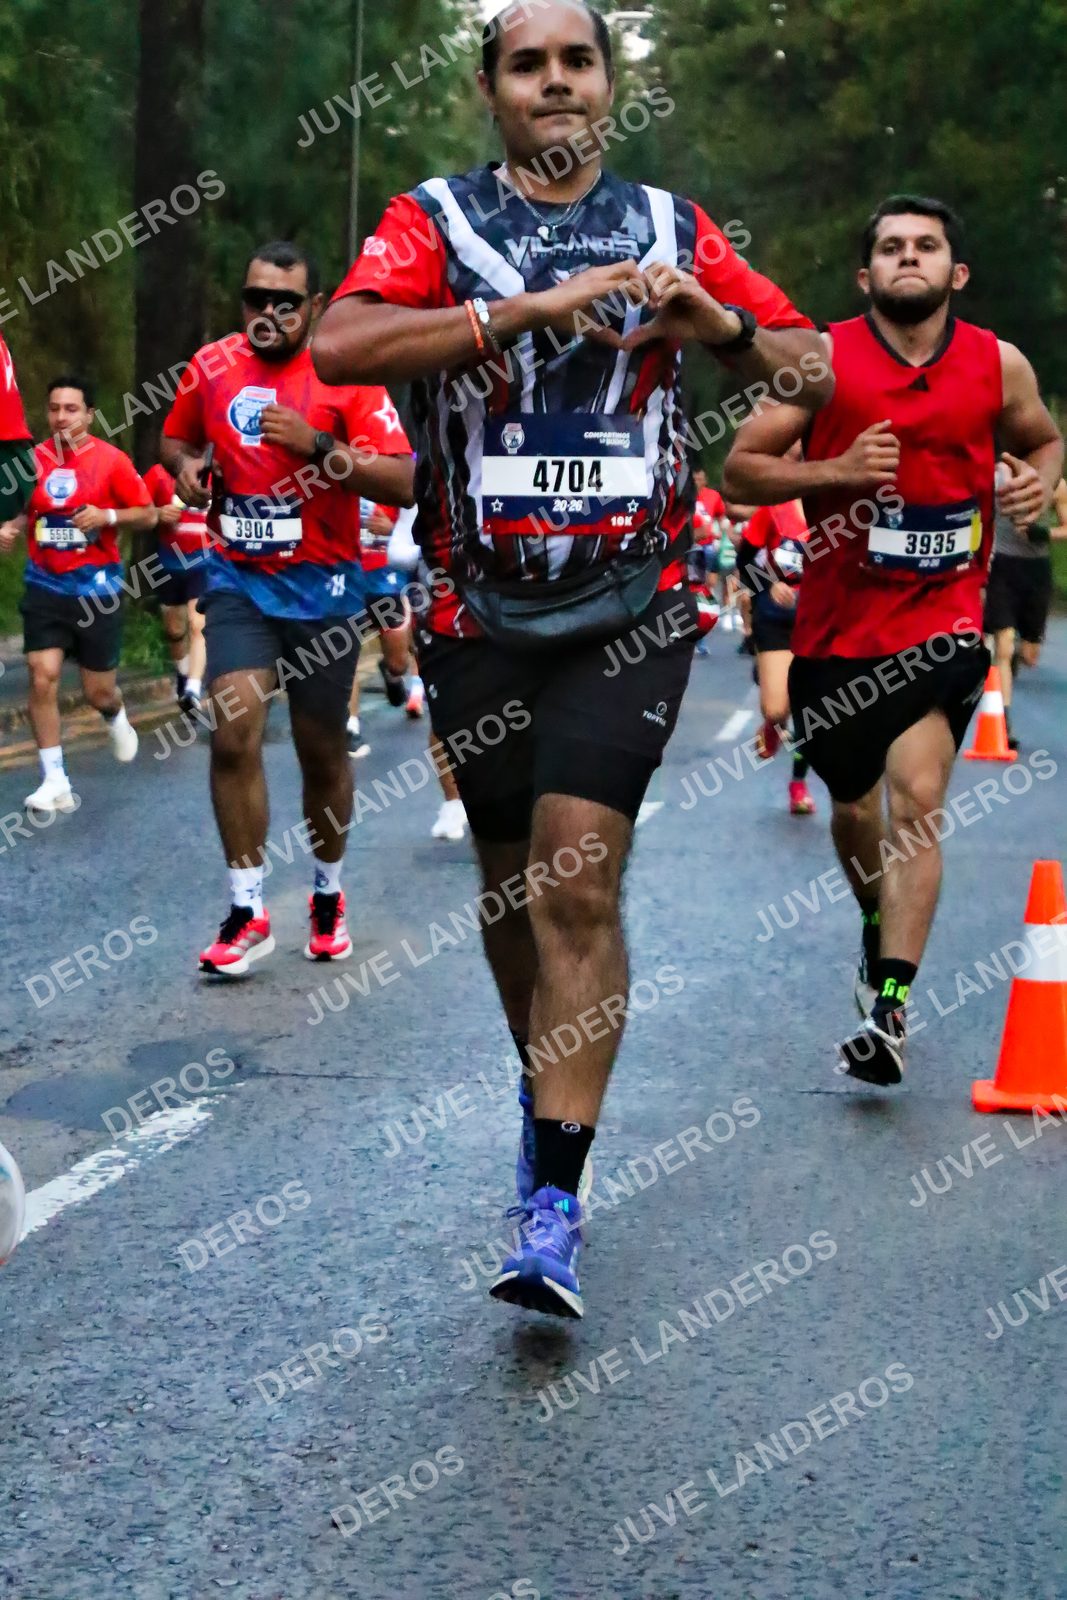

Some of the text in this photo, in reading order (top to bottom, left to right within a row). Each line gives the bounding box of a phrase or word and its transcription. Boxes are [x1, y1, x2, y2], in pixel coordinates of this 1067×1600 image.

[533, 460, 603, 492] 4704
[235, 519, 274, 539] 3904
[611, 516, 633, 526] 10K
[905, 532, 956, 555] 3935
